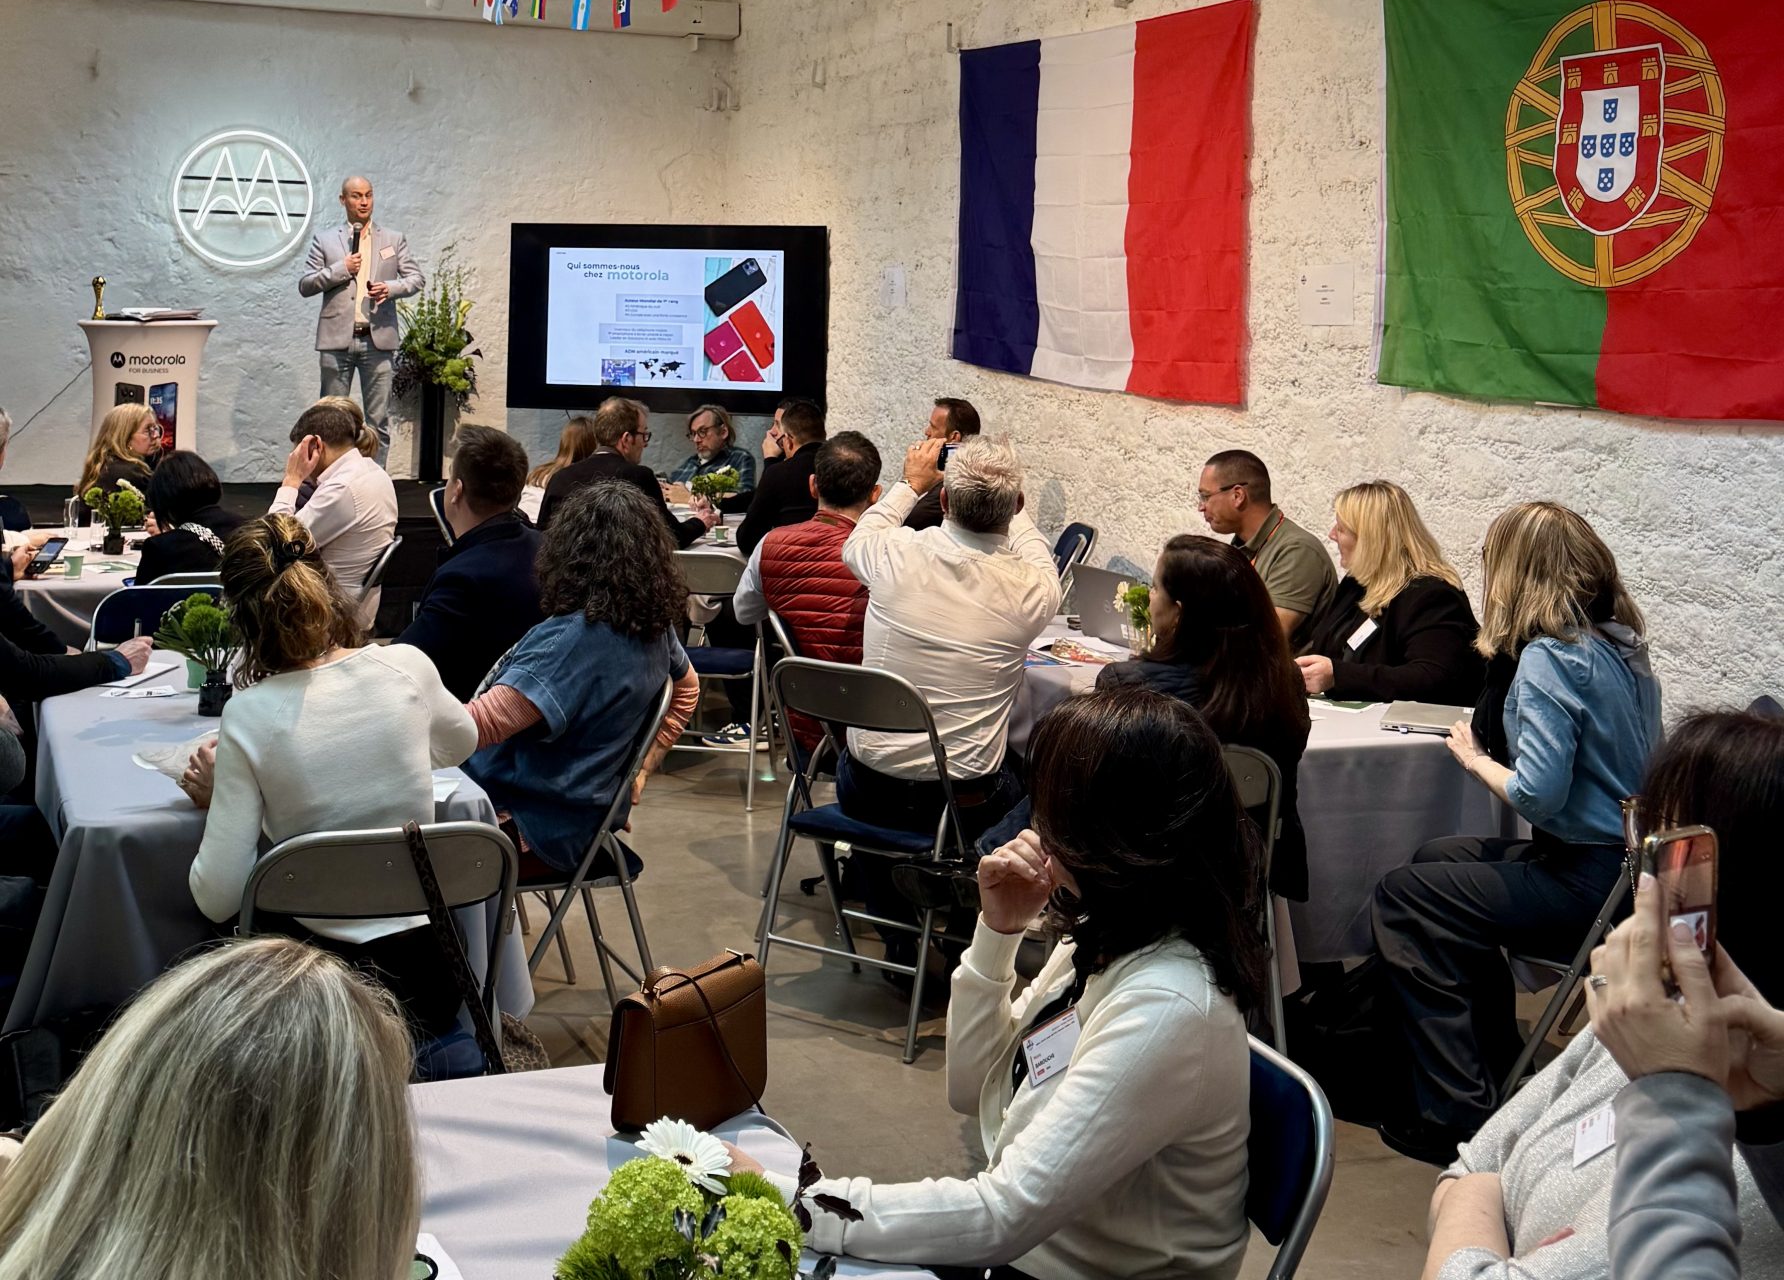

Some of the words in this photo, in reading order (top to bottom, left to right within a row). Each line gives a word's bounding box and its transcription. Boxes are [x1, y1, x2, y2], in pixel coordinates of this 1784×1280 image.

[567, 262, 581, 270] Qui
[583, 262, 640, 270] sommes-nous
[607, 270, 669, 281] motorola
[129, 354, 186, 365] motorola
